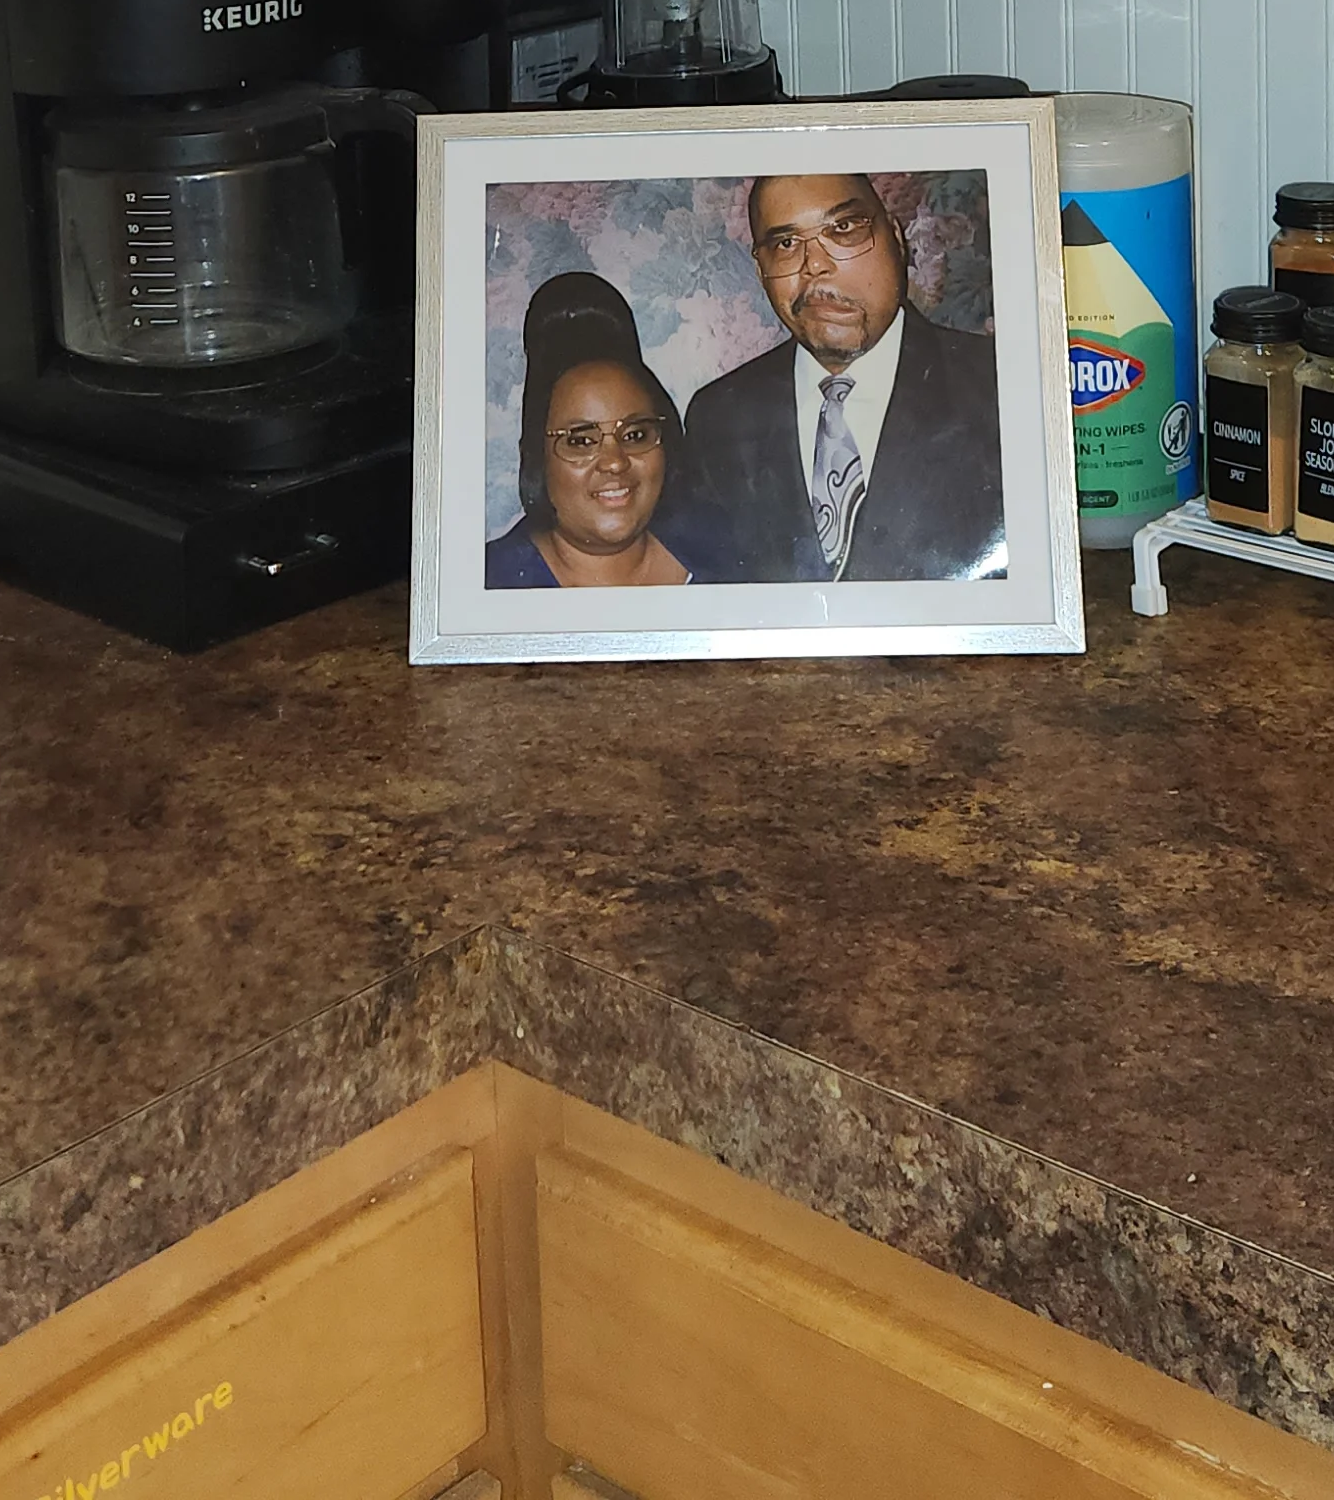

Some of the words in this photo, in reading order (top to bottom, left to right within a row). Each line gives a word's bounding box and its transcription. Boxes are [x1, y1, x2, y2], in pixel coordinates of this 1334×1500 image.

[126, 193, 136, 203] 12
[128, 224, 139, 233] 10
[130, 256, 137, 264] 8
[131, 287, 139, 296] 6
[133, 318, 141, 326] 4
[1105, 423, 1146, 438] WIPES
[1213, 421, 1261, 446] CINNAMON
[37, 1381, 234, 1500] lverware
